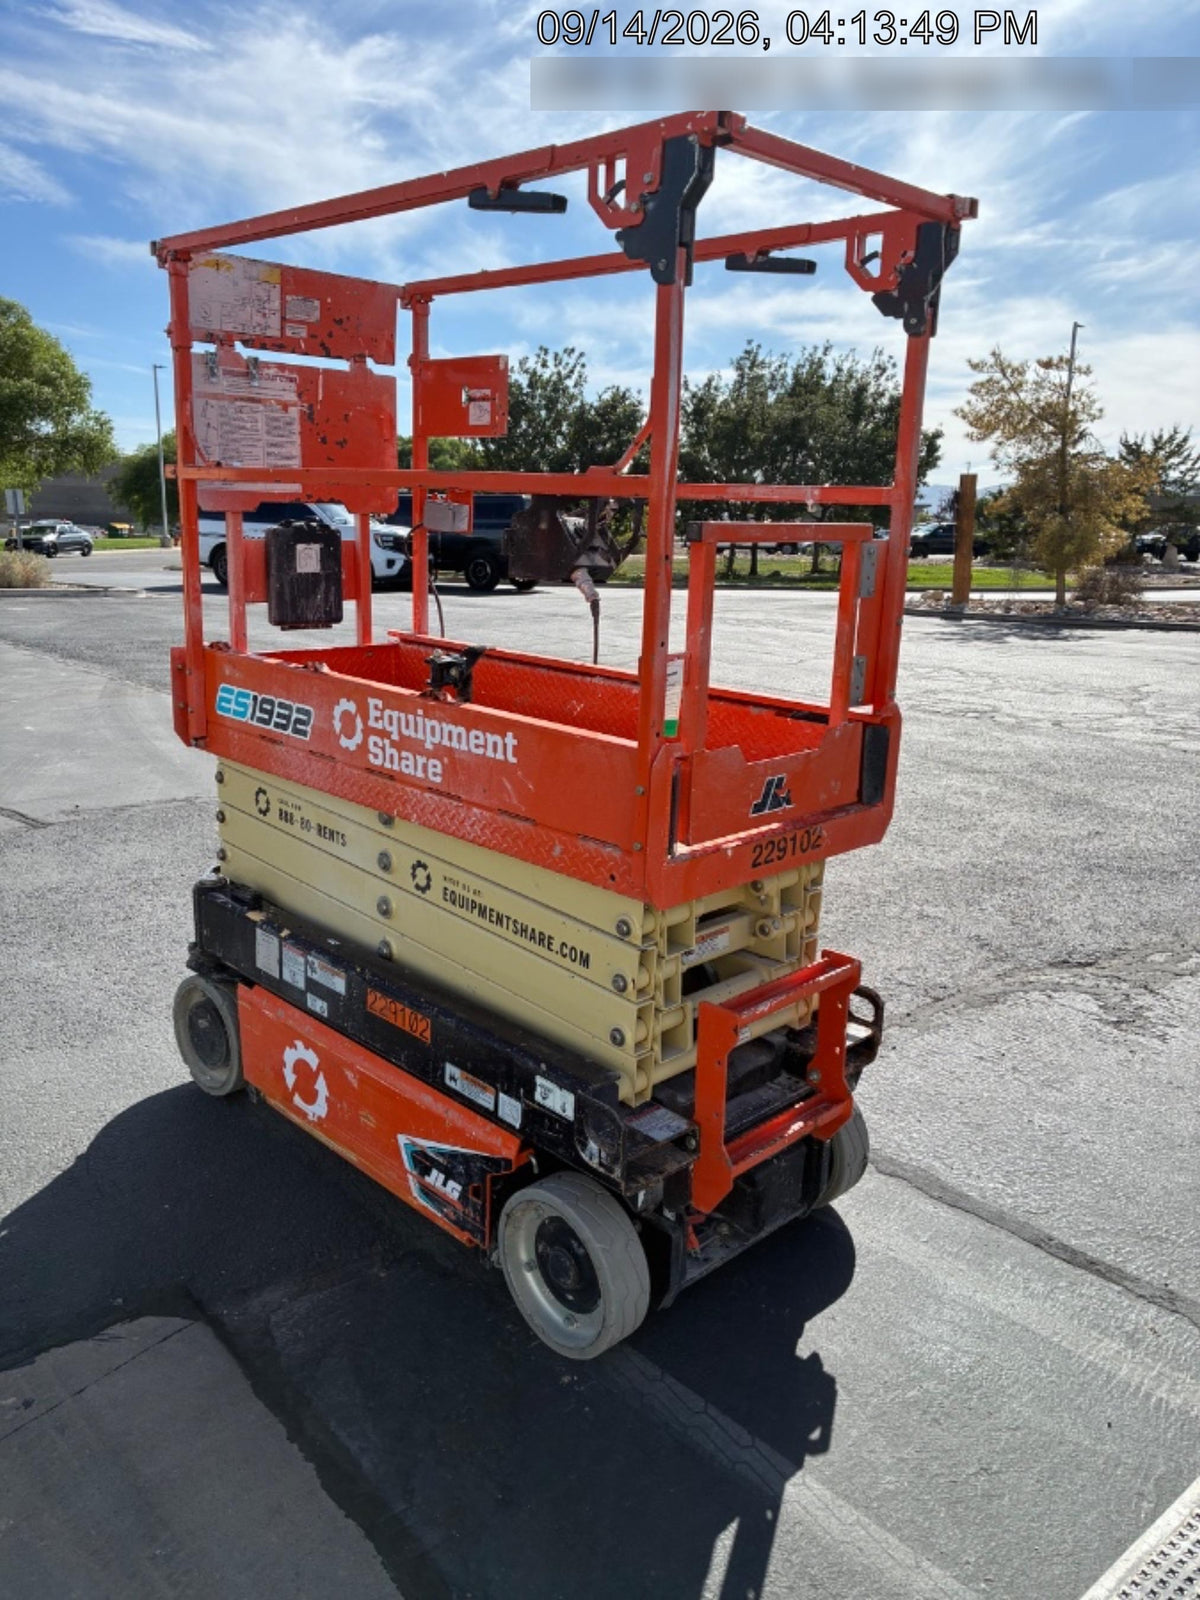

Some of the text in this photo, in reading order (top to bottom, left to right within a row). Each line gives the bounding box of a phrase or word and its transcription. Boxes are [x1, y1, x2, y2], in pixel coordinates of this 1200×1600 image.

[216, 683, 314, 740] ES1932
[367, 697, 518, 764] Equipment
[367, 735, 443, 784] Share
[751, 826, 824, 868] 229102
[442, 886, 591, 970] EQUIPMENTSHARE.COM
[368, 989, 429, 1041] 229102
[424, 1168, 463, 1201] JLG
